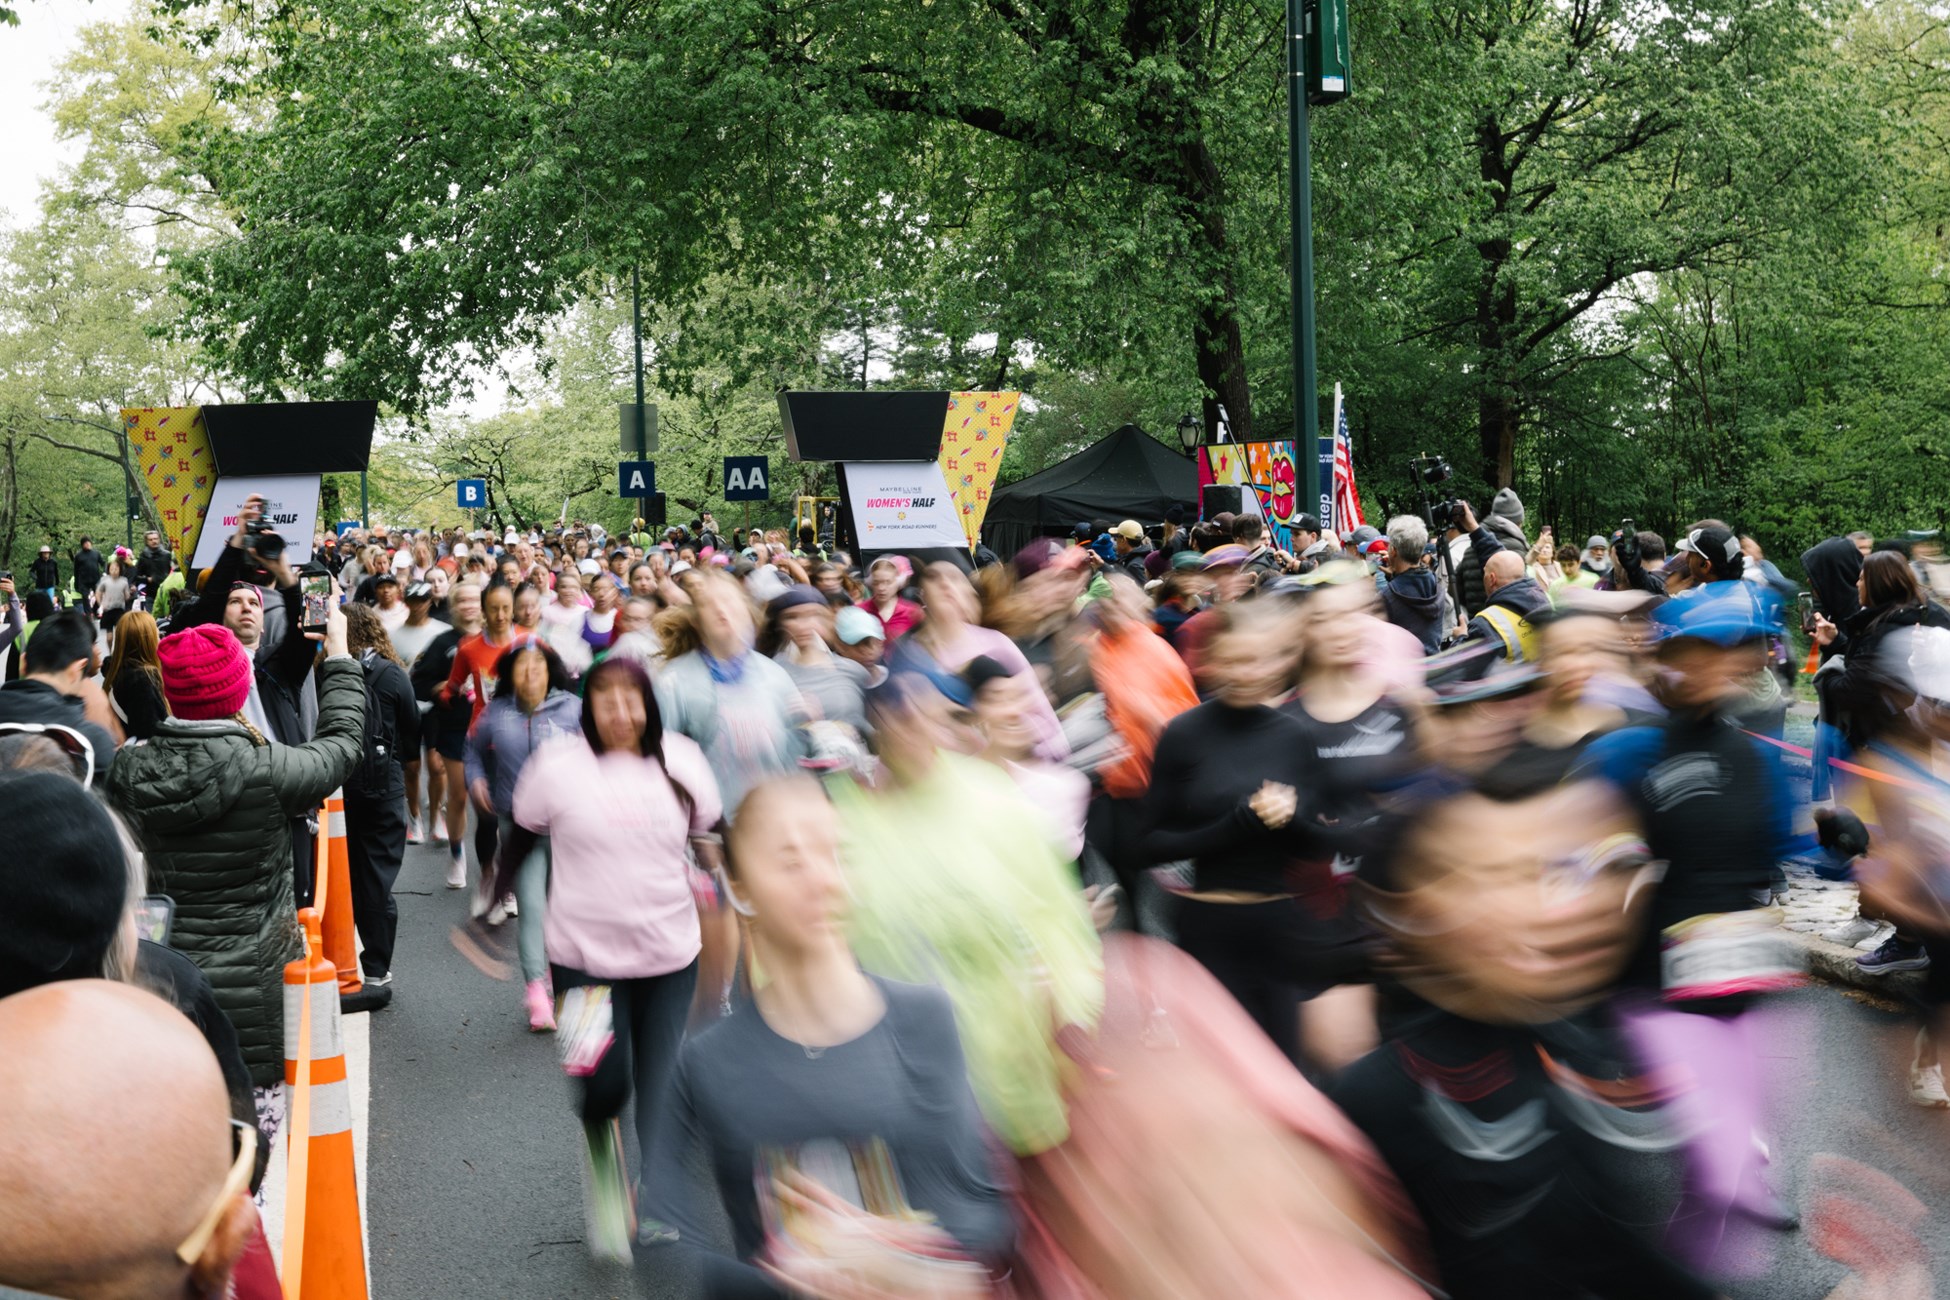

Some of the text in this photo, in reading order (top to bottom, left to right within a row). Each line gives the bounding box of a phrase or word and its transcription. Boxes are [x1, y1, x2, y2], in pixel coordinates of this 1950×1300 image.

[629, 470, 646, 489] A
[727, 467, 766, 490] AA
[465, 486, 477, 501] B
[866, 497, 936, 508] WOMEN'S HALF
